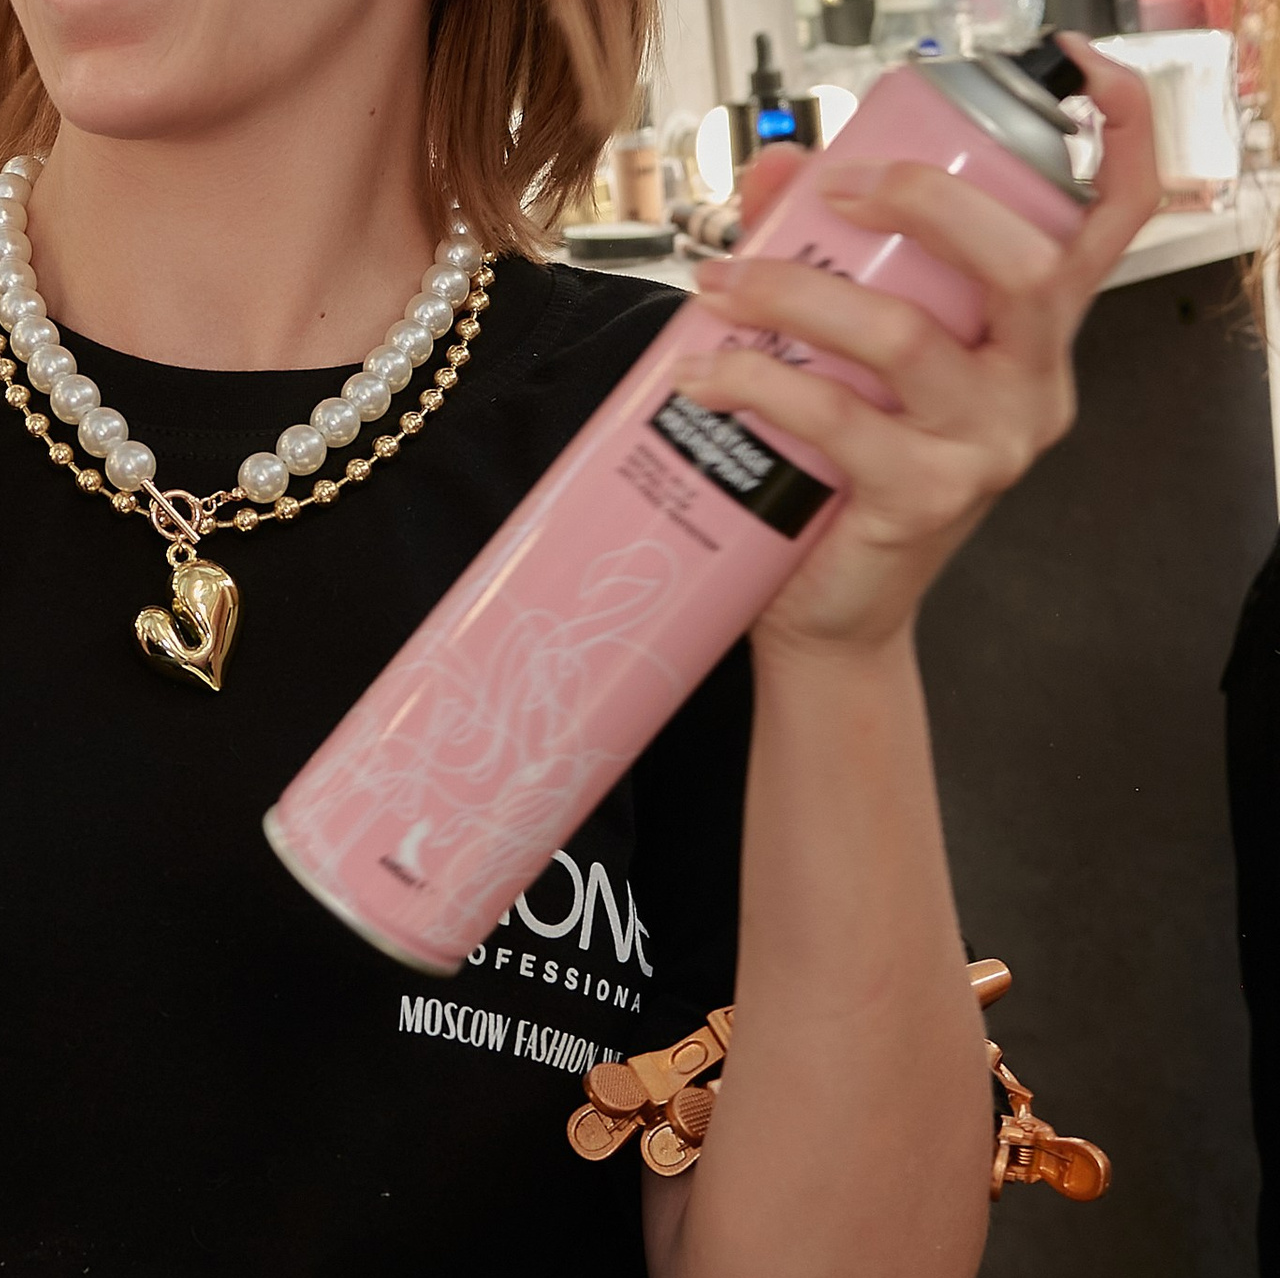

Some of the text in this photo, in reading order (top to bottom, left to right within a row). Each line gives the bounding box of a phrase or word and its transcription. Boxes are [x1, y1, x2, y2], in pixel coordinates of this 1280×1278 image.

[498, 849, 654, 978] ON
[467, 943, 641, 1013] OFESSIONA
[398, 995, 600, 1075] MOSCOW FASHION
